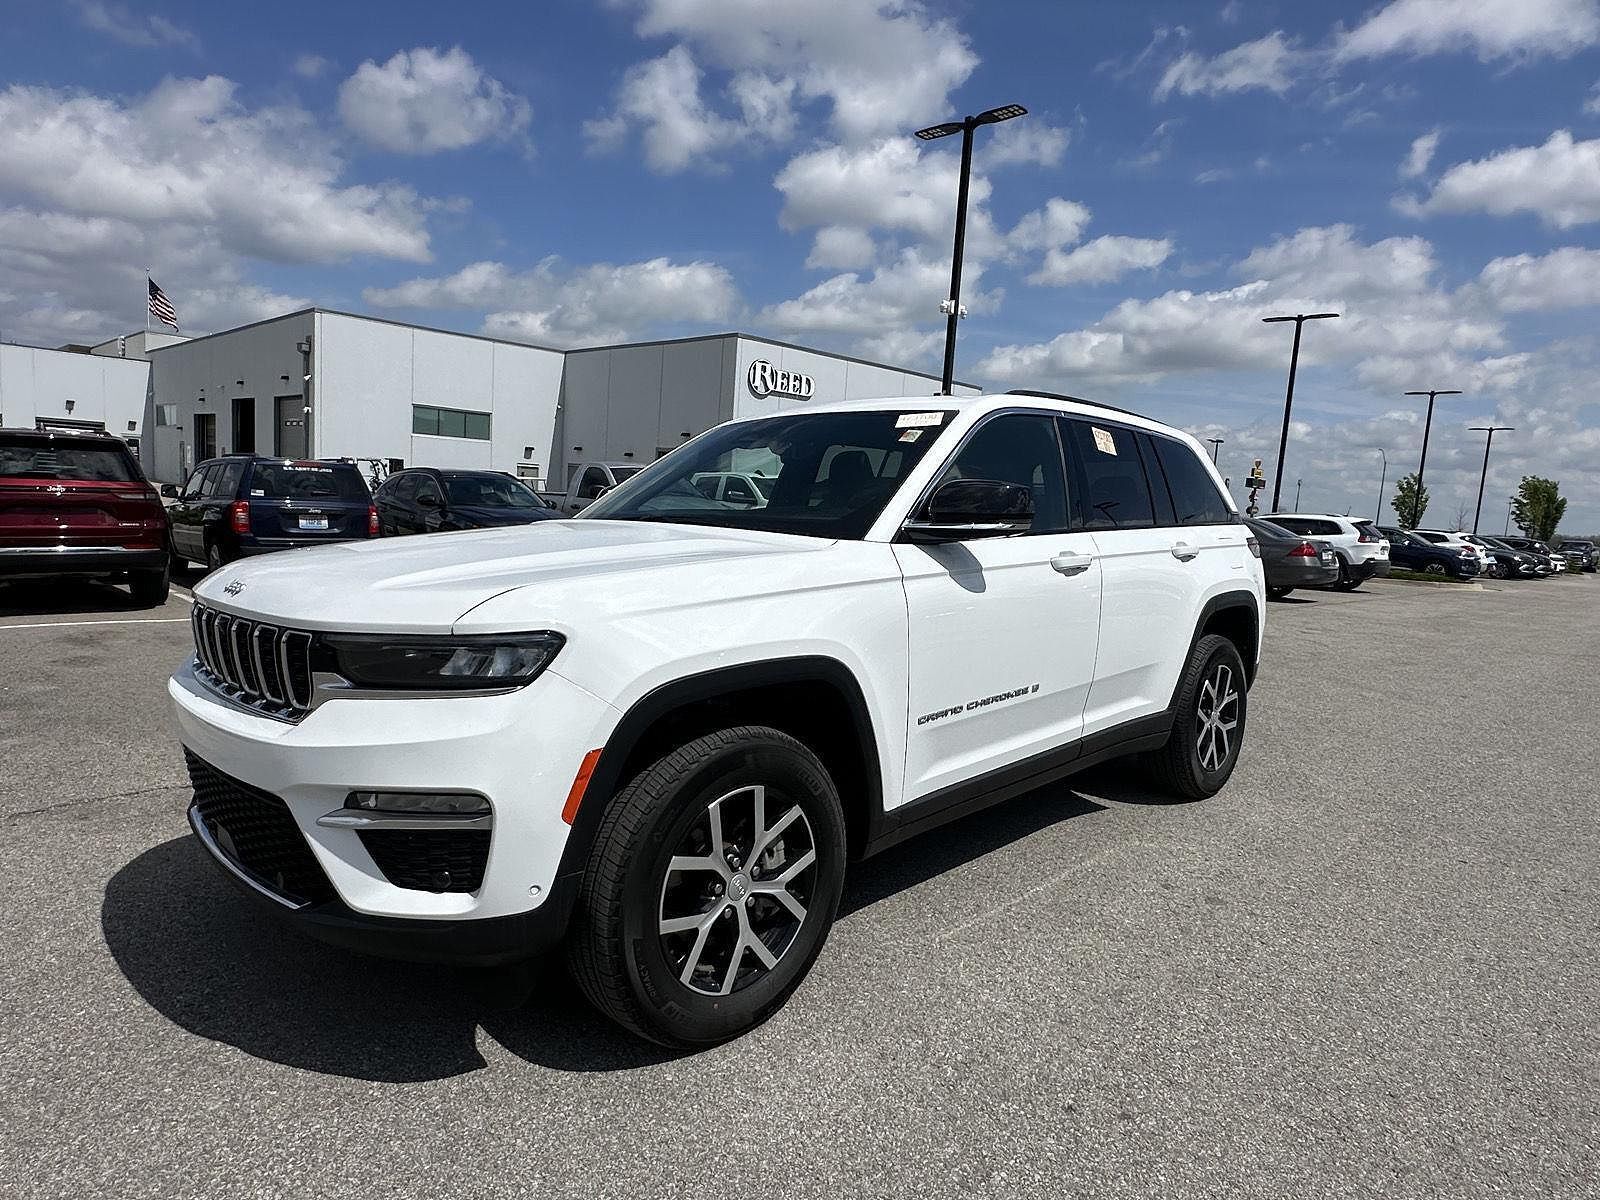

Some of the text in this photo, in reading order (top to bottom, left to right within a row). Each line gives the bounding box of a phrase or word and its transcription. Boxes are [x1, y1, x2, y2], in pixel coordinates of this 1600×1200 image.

[46, 485, 66, 493] Jeep
[917, 686, 1031, 726] GRAND CHEROKEE
